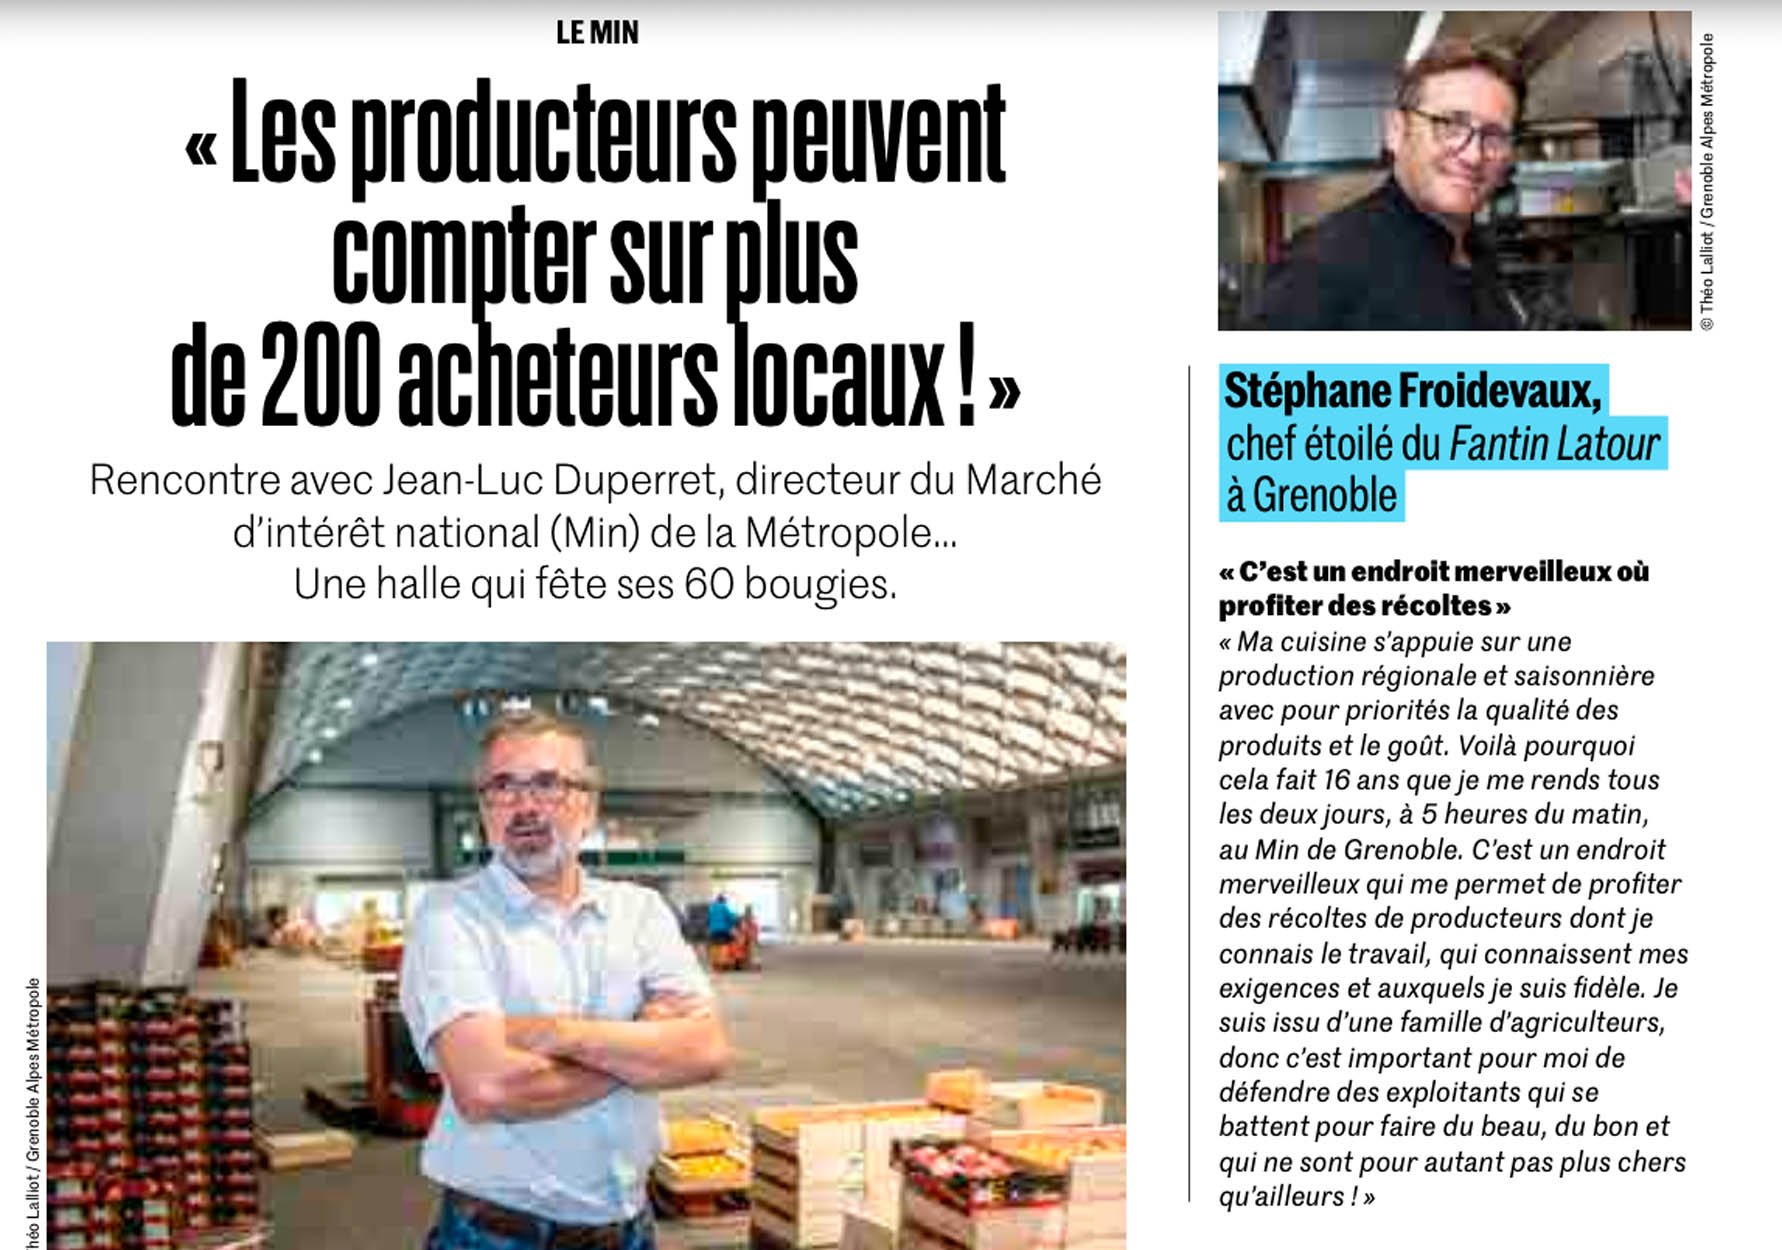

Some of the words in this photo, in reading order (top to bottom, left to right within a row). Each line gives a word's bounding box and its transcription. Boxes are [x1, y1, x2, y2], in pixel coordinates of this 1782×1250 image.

[557, 19, 584, 44] LE
[590, 19, 638, 44] MIN
[1699, 33, 1716, 106] Métropole
[232, 77, 336, 184] Les
[352, 77, 737, 203] producteurs
[753, 83, 1006, 203] peuvent
[1699, 111, 1716, 148] Alpes
[1699, 153, 1712, 218] Grenoble
[333, 205, 597, 324] compter
[610, 220, 713, 304] sur
[727, 199, 858, 324] plus
[1699, 232, 1712, 274] Lalliot
[1699, 278, 1712, 313] Théo
[172, 321, 246, 427] de
[262, 320, 381, 427] 200
[399, 321, 718, 427] acheteurs
[734, 321, 945, 427] locaux
[1223, 369, 1392, 415] Stéphane
[1399, 369, 1601, 415] Froidevaux,
[1226, 422, 1297, 461] chef
[1304, 422, 1393, 461] étoilé
[1401, 422, 1439, 461] du
[1449, 423, 1549, 461] Fantin
[1556, 423, 1661, 461] Latour
[92, 462, 280, 494] Rencontre
[290, 471, 372, 494] avec
[383, 463, 542, 495] Jean-Luc
[555, 462, 723, 503] Duperret,
[736, 460, 900, 494] directeur
[910, 460, 953, 494] du
[968, 460, 1100, 495] Marché
[1226, 474, 1246, 512] à
[1253, 473, 1397, 512] Grenoble
[233, 513, 385, 547] d’intérêt
[396, 513, 538, 547] national
[551, 513, 639, 552] (Min)
[651, 513, 695, 547] de
[707, 513, 736, 547] la
[295, 567, 365, 599] Une
[378, 564, 460, 599] halle
[471, 568, 524, 608] qui
[535, 564, 606, 599] fête
[617, 575, 673, 599] ses
[685, 566, 733, 599] 60
[746, 564, 895, 609] bougies.
[1239, 560, 1307, 581] C’est
[1313, 565, 1345, 581] un
[1351, 558, 1450, 581] endroit
[1454, 558, 1612, 581] merveilleux
[1616, 559, 1649, 581] où
[1218, 663, 1353, 690] production
[1361, 663, 1476, 690] régionale
[1483, 664, 1508, 685] et
[1514, 664, 1654, 686] saisonnière
[25, 978, 42, 1051] Métropole
[25, 1054, 42, 1093] Alpes
[25, 1097, 39, 1161] Grenoble
[25, 1175, 39, 1218] Lalliot
